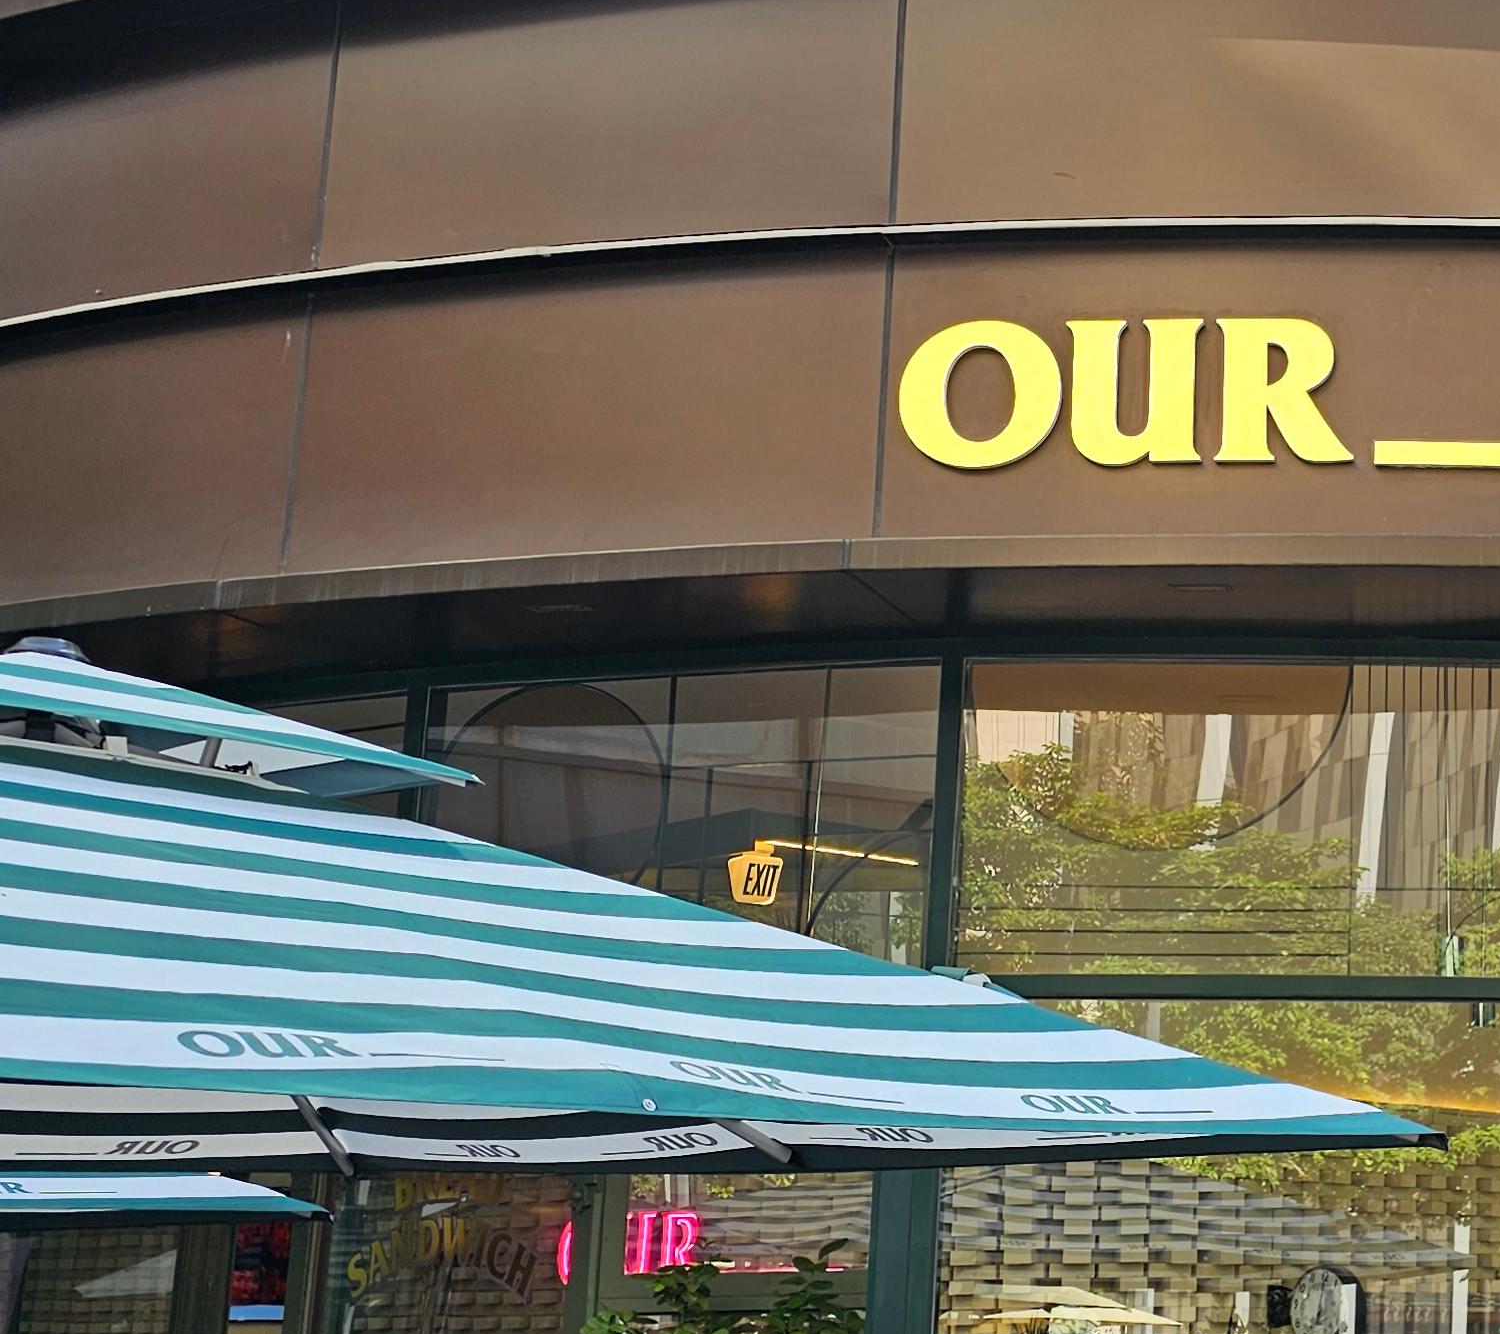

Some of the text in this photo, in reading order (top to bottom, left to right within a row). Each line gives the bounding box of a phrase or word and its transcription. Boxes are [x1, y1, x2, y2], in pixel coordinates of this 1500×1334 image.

[897, 317, 1354, 469] OUR
[743, 862, 780, 897] EXIT
[177, 1029, 363, 1059] OUR
[670, 1059, 804, 1094] OUR
[1020, 1093, 1128, 1115] OUR
[346, 1215, 539, 1301] SANDWICH
